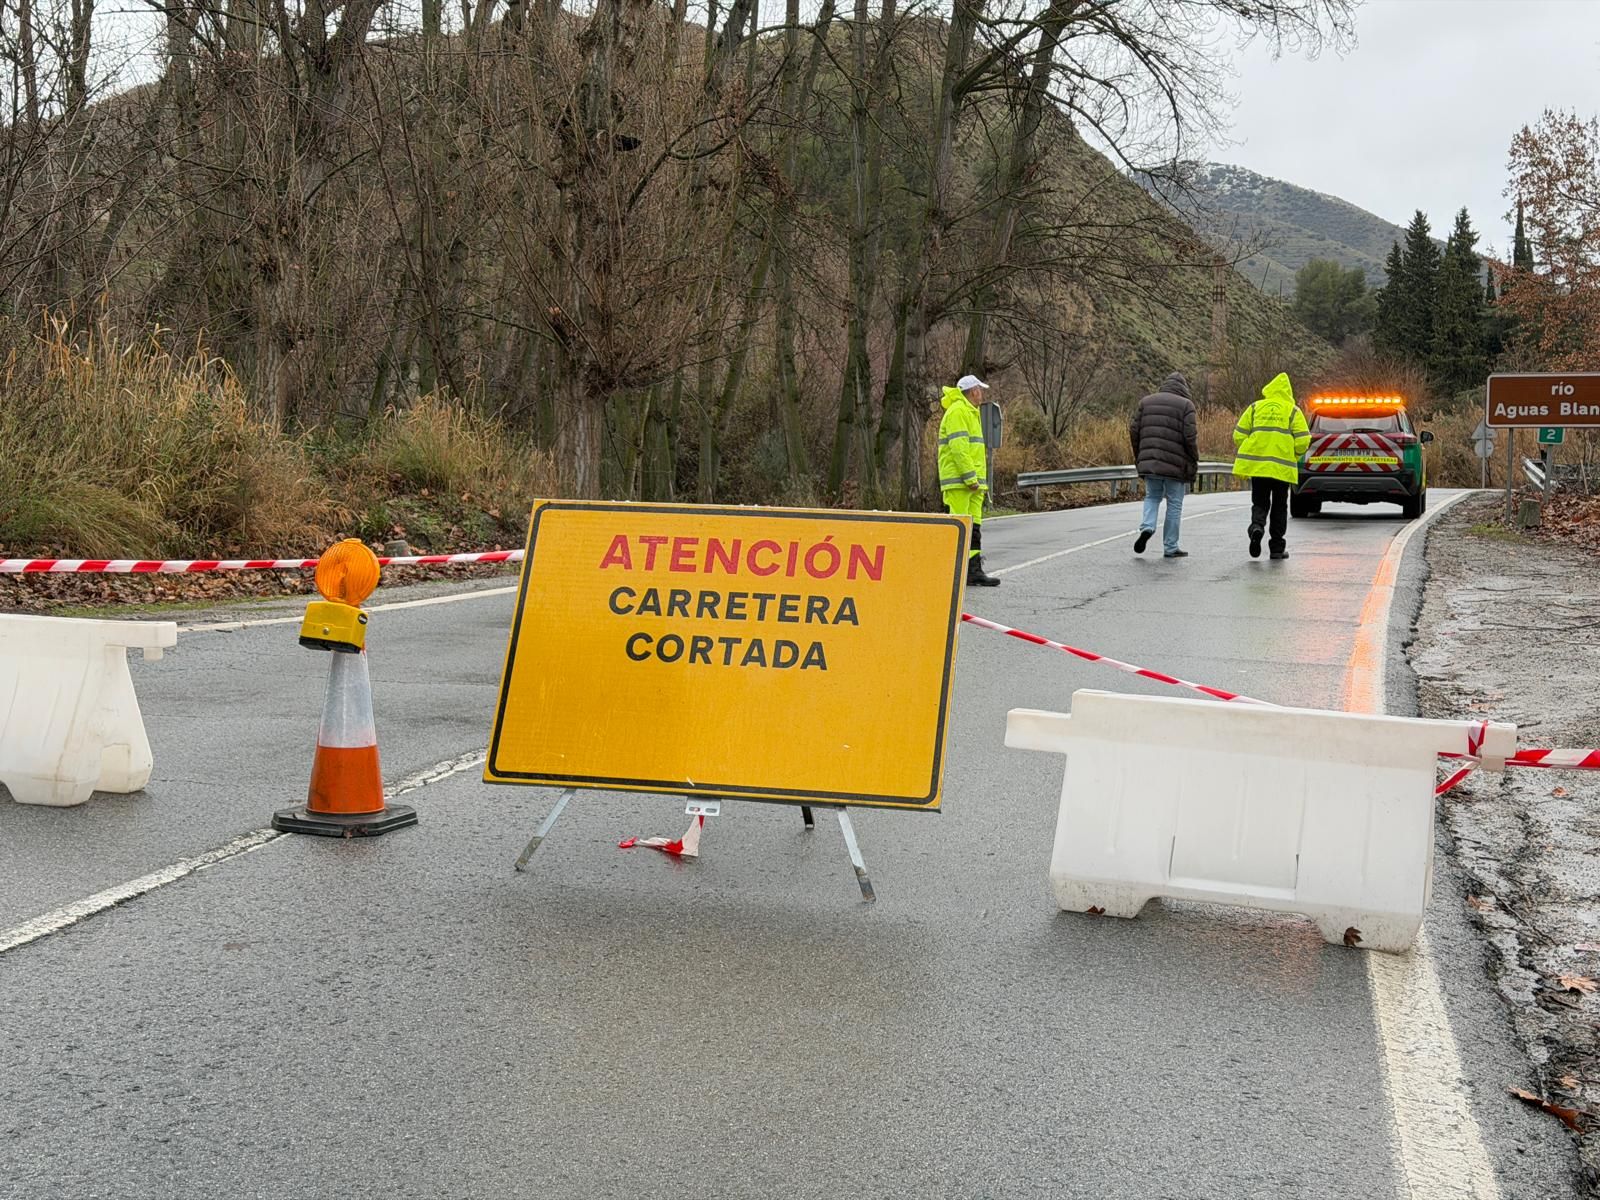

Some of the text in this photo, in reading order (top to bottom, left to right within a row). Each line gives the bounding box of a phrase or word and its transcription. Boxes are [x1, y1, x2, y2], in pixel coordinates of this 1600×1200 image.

[1551, 381, 1575, 396] río
[1494, 401, 1600, 419] Aguas Blan
[1546, 428, 1556, 440] 2
[599, 534, 886, 582] ATENCIÓN
[608, 586, 860, 626] CARRETERA
[625, 632, 828, 671] CORTADA
